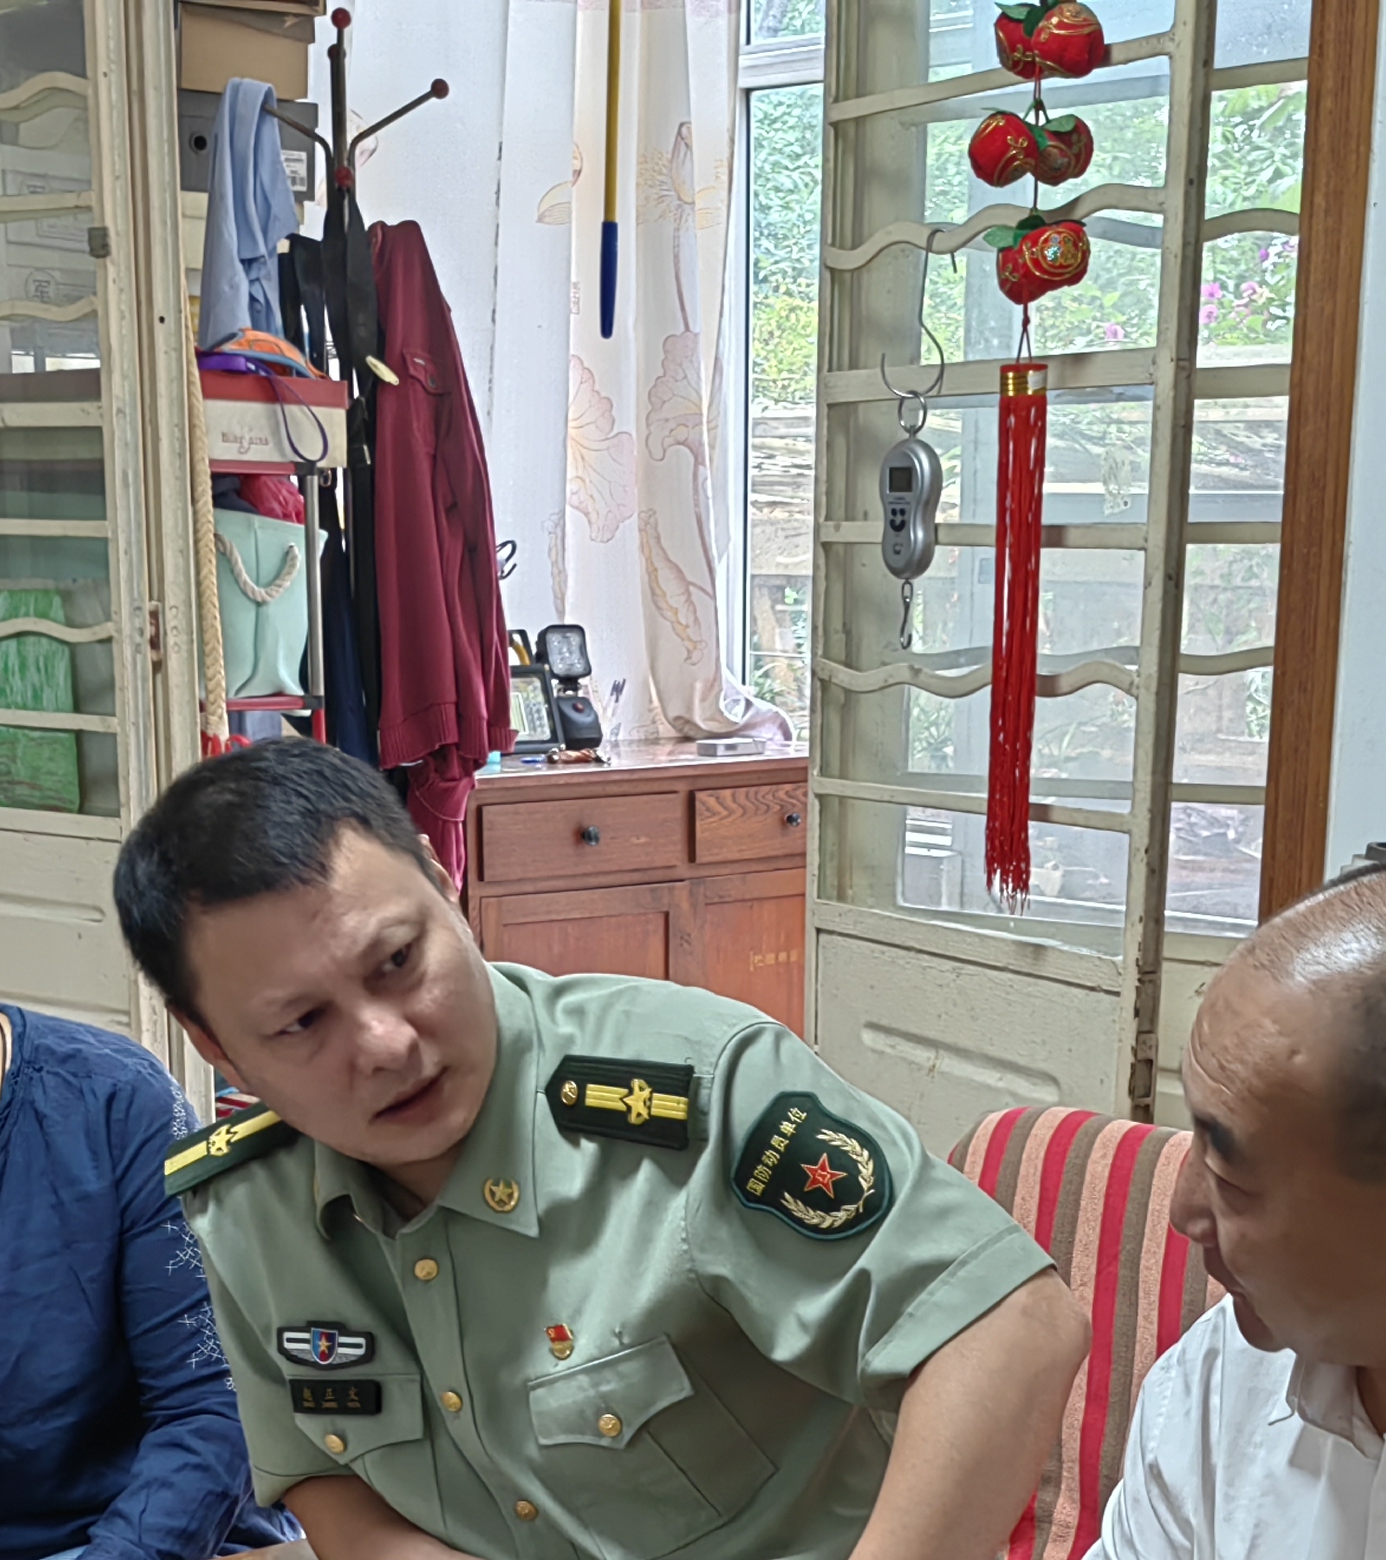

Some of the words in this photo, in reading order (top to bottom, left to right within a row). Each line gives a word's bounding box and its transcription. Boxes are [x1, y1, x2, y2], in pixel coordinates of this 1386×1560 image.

[746, 1107, 807, 1197] 国防动员单位
